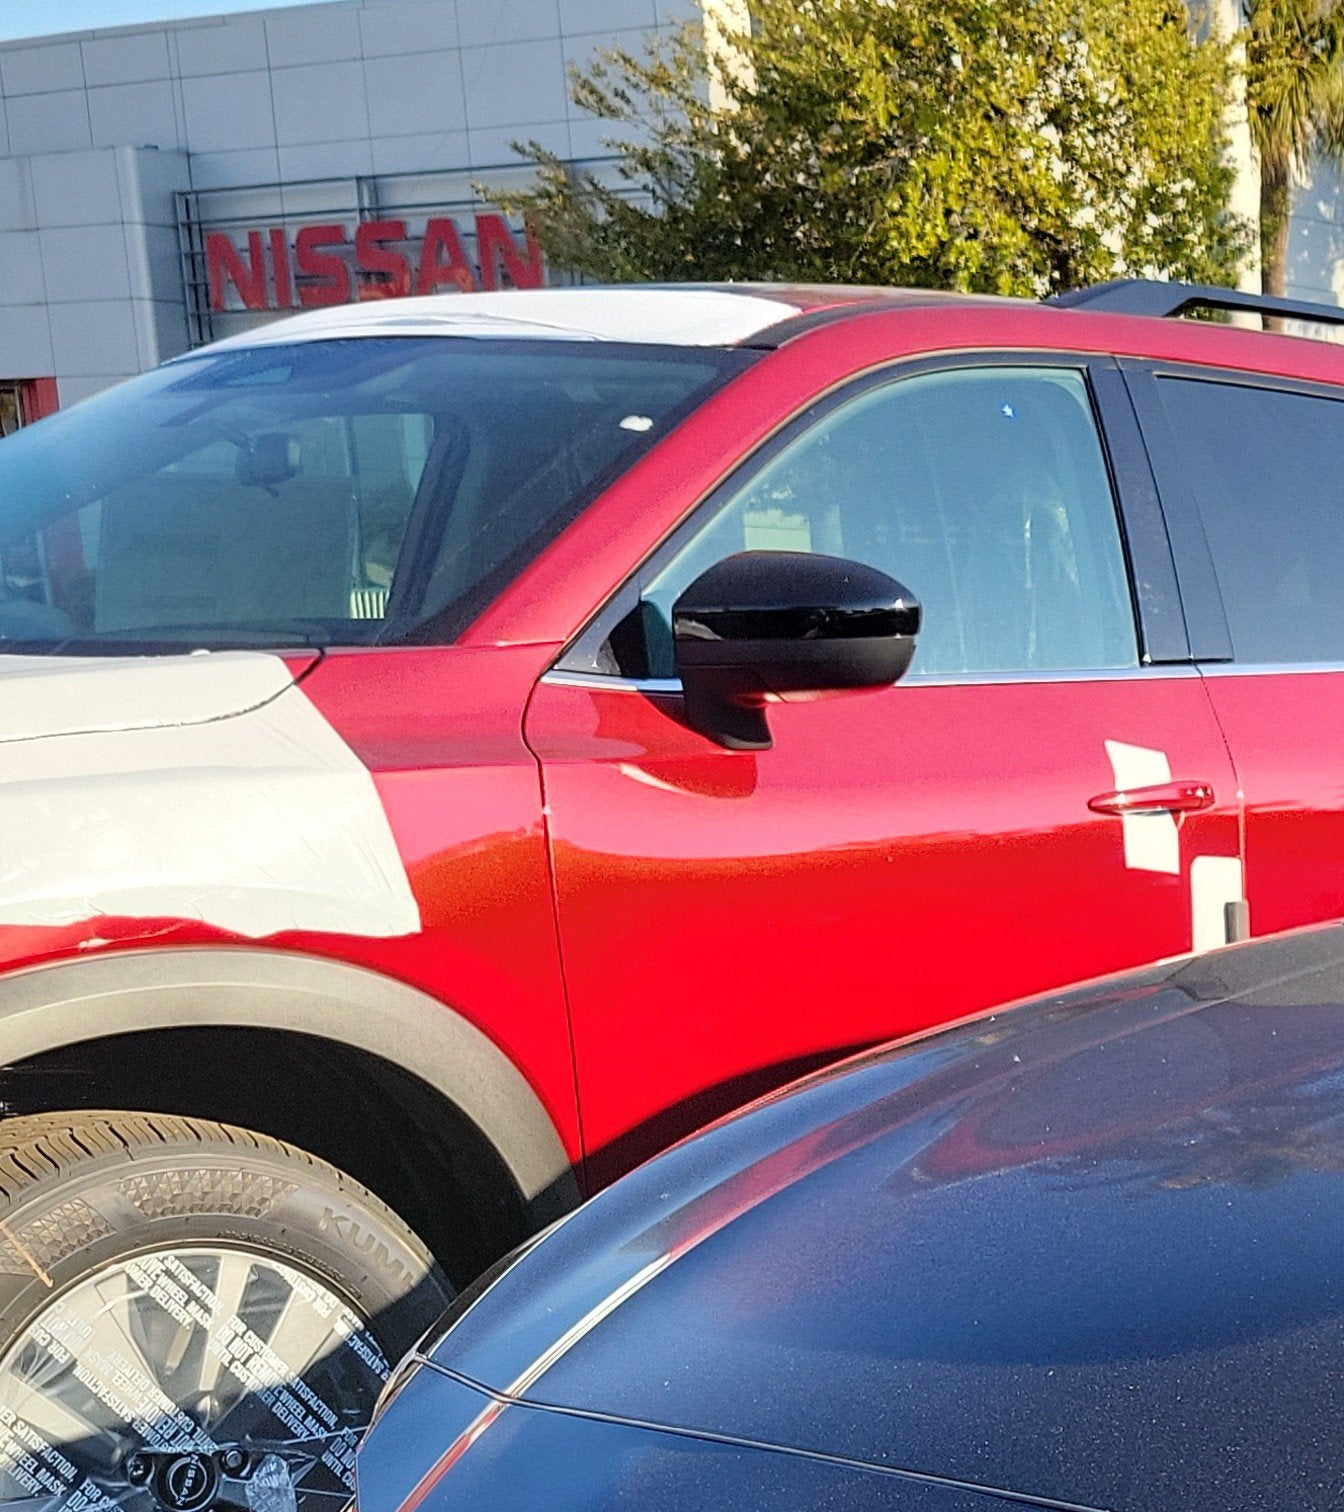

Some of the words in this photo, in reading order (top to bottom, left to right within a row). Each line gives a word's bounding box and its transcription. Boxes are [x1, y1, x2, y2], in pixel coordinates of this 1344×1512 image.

[204, 213, 546, 312] NISSAN
[4, 1439, 38, 1475] WHEEL
[35, 1467, 67, 1498] MASK
[13, 1420, 78, 1483] SATISFACTION,
[66, 1489, 88, 1512] DO
[79, 1479, 102, 1503] FOR
